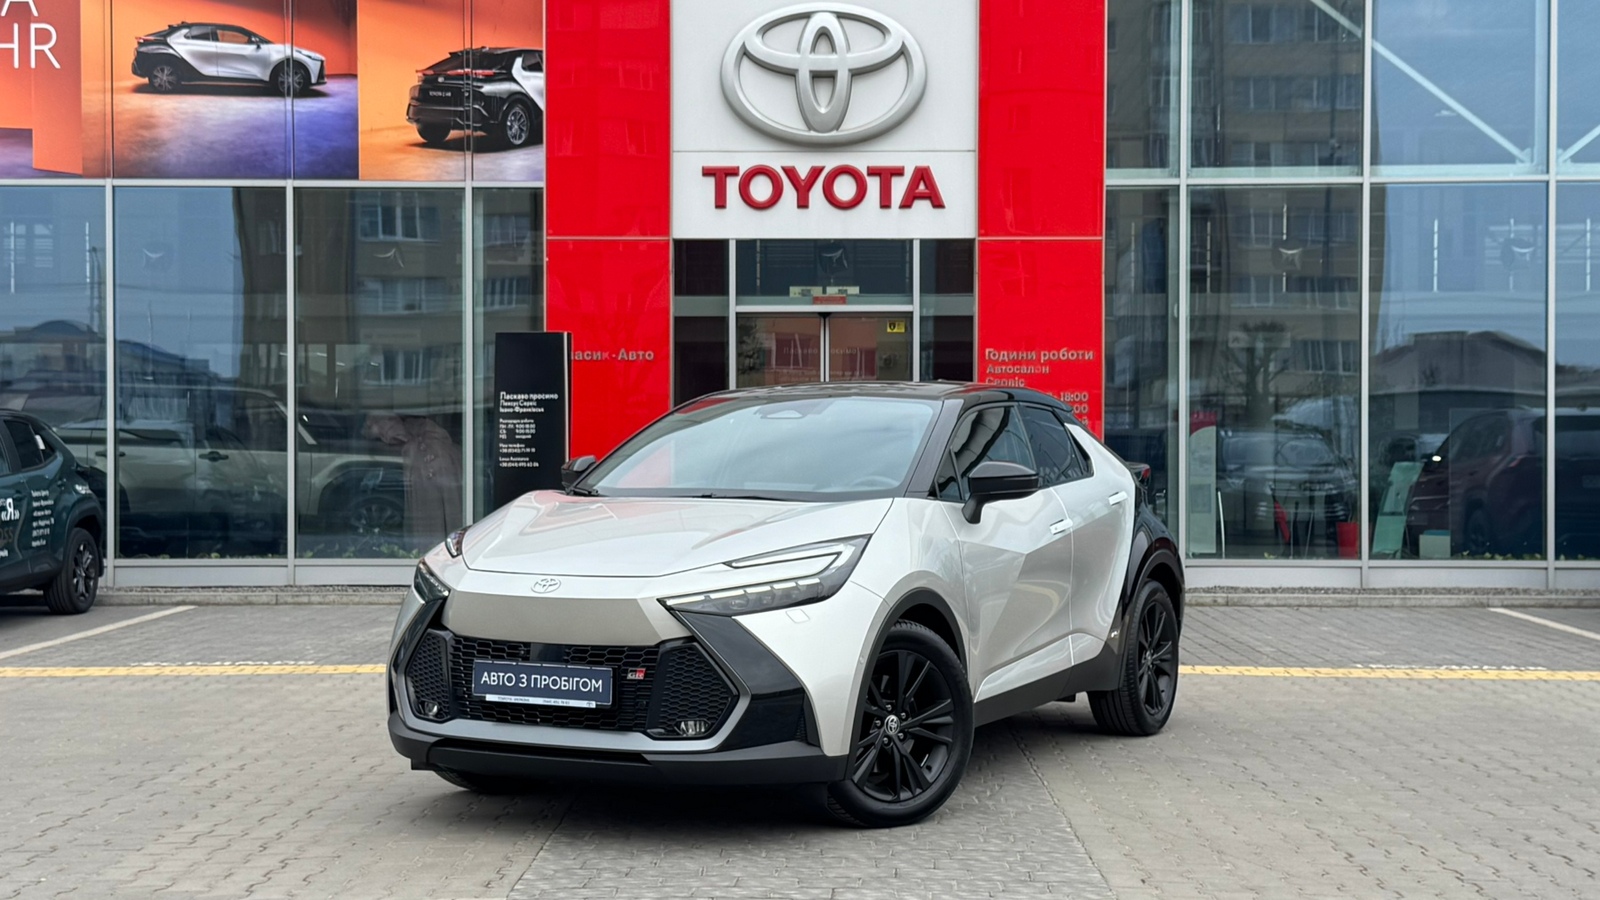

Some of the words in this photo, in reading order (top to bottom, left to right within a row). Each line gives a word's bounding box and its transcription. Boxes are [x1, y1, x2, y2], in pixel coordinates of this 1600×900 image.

[702, 164, 946, 210] TOYOTA
[571, 348, 655, 361] асик-Авто
[985, 348, 1036, 362] Години
[1040, 347, 1094, 363] роботи
[986, 364, 1050, 374] Автосалон
[529, 393, 559, 401] просимо
[1060, 392, 1089, 402] 18:00
[480, 671, 516, 686] АВТО
[518, 674, 528, 687] З
[530, 675, 603, 693] ПРОБІГОМ
